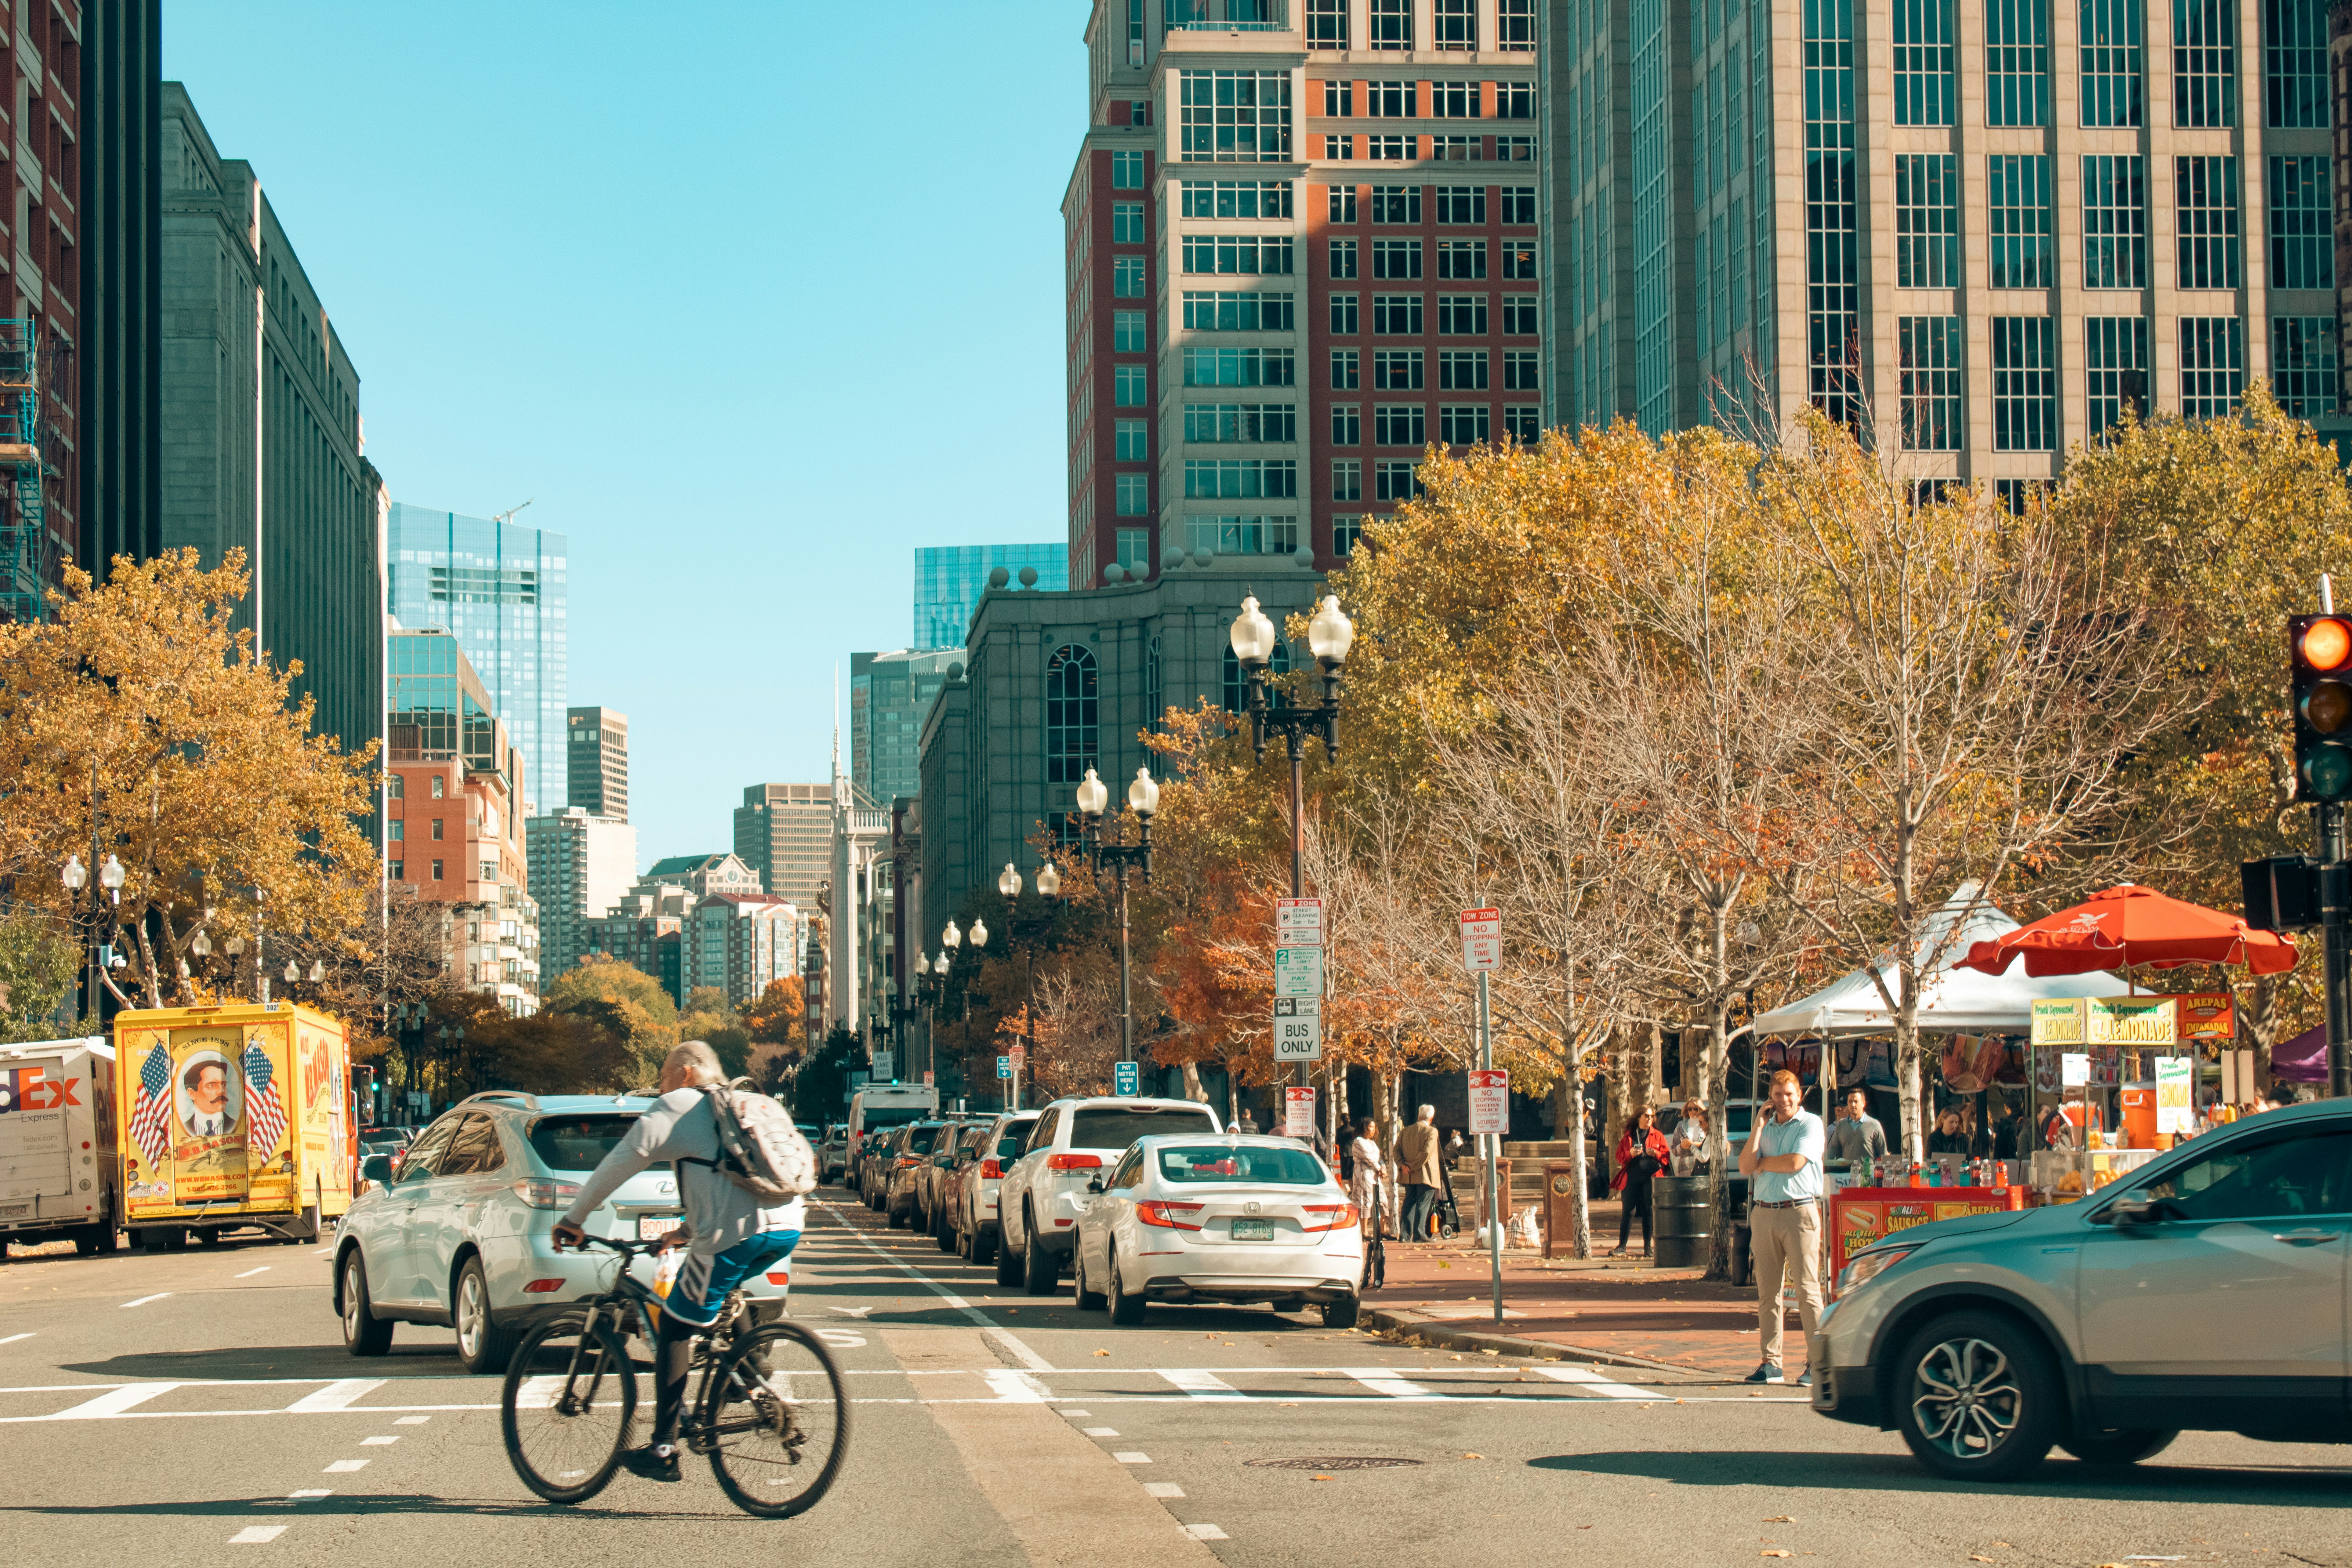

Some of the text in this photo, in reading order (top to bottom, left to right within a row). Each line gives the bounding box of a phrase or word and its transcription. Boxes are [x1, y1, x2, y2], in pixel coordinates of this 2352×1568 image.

[1478, 911, 1497, 919] ZONE
[1279, 951, 1287, 960] 2
[2035, 1003, 2074, 1016] Fresh Squeezed
[2092, 1003, 2158, 1016] Fresh Squeezed
[2186, 998, 2227, 1011] AREPAS
[1286, 1024, 1308, 1037] BUS
[2044, 1019, 2082, 1041] LEMONADE
[2108, 1019, 2171, 1041] LEMONADE
[2185, 1022, 2229, 1036] EMPANADAS
[182, 1037, 230, 1051] SINCE 1898
[1281, 1040, 1313, 1053] ONLY
[2158, 1066, 2189, 1080] Squeezed
[0, 1066, 82, 1114] dEx
[2158, 1083, 2189, 1108] LEMONADE
[21, 1112, 59, 1123] Express
[175, 1174, 246, 1183] WWW.WBMASON.COM
[187, 1184, 237, 1192] 1-888-926-2766
[1896, 1205, 1922, 1215] ITALIAN
[1965, 1206, 2000, 1216] AREPAS
[1234, 1223, 1248, 1233] 452
[1849, 1238, 1874, 1247] HOT
